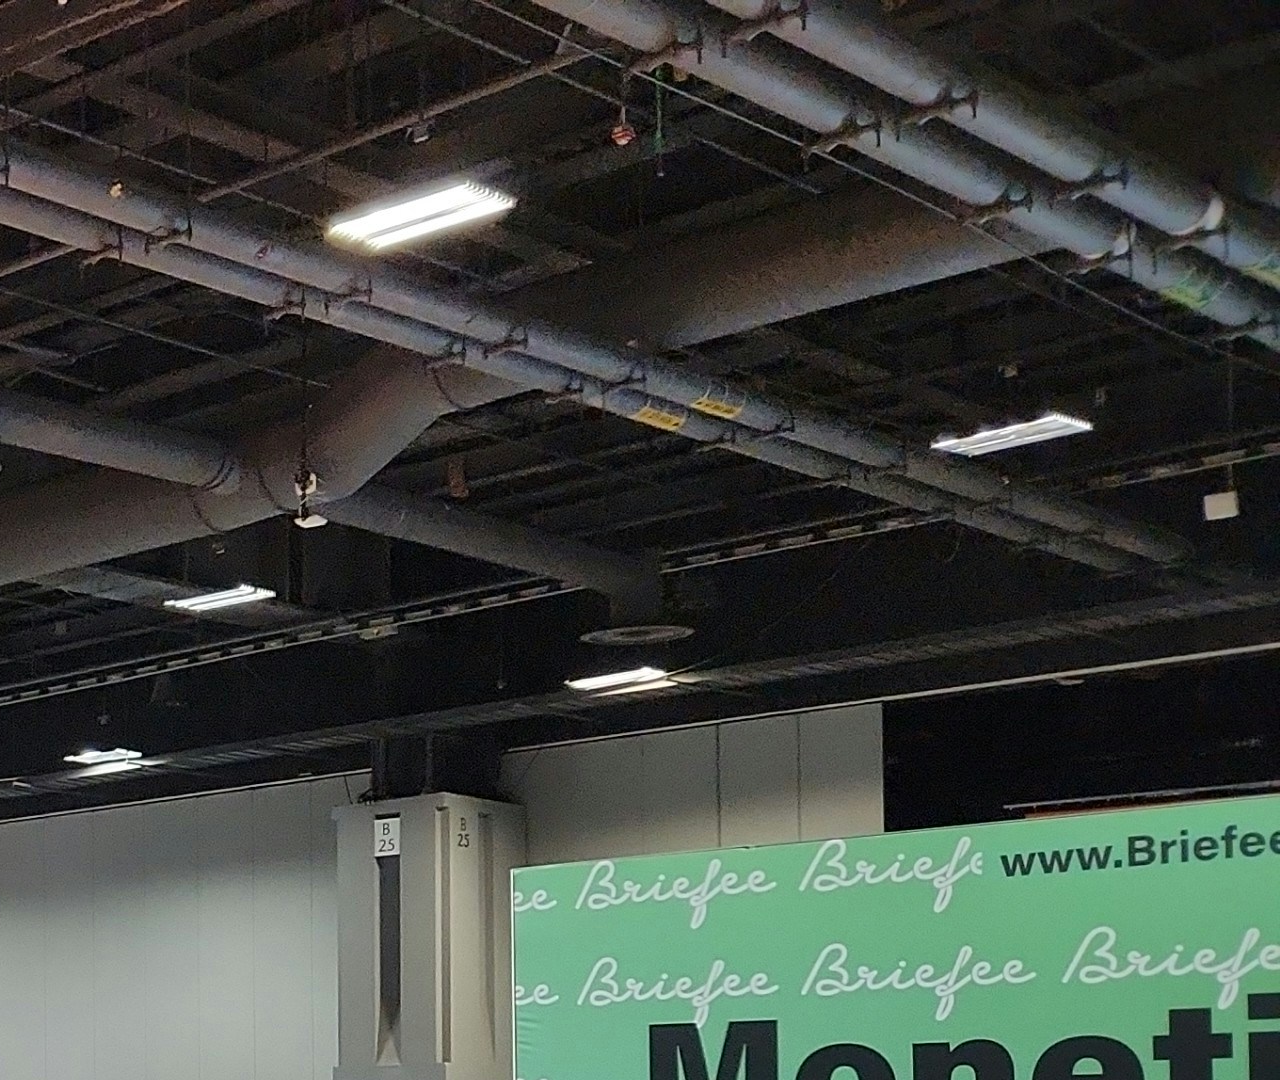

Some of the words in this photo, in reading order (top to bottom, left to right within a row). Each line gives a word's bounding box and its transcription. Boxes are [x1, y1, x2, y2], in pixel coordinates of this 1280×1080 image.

[382, 822, 391, 836] B
[460, 817, 467, 832] B
[378, 838, 395, 853] 25
[457, 833, 470, 848] 25
[575, 860, 777, 929] Briefee
[800, 836, 983, 913] Brief
[577, 957, 780, 1028] Briefee
[801, 943, 1037, 1021] Briefee
